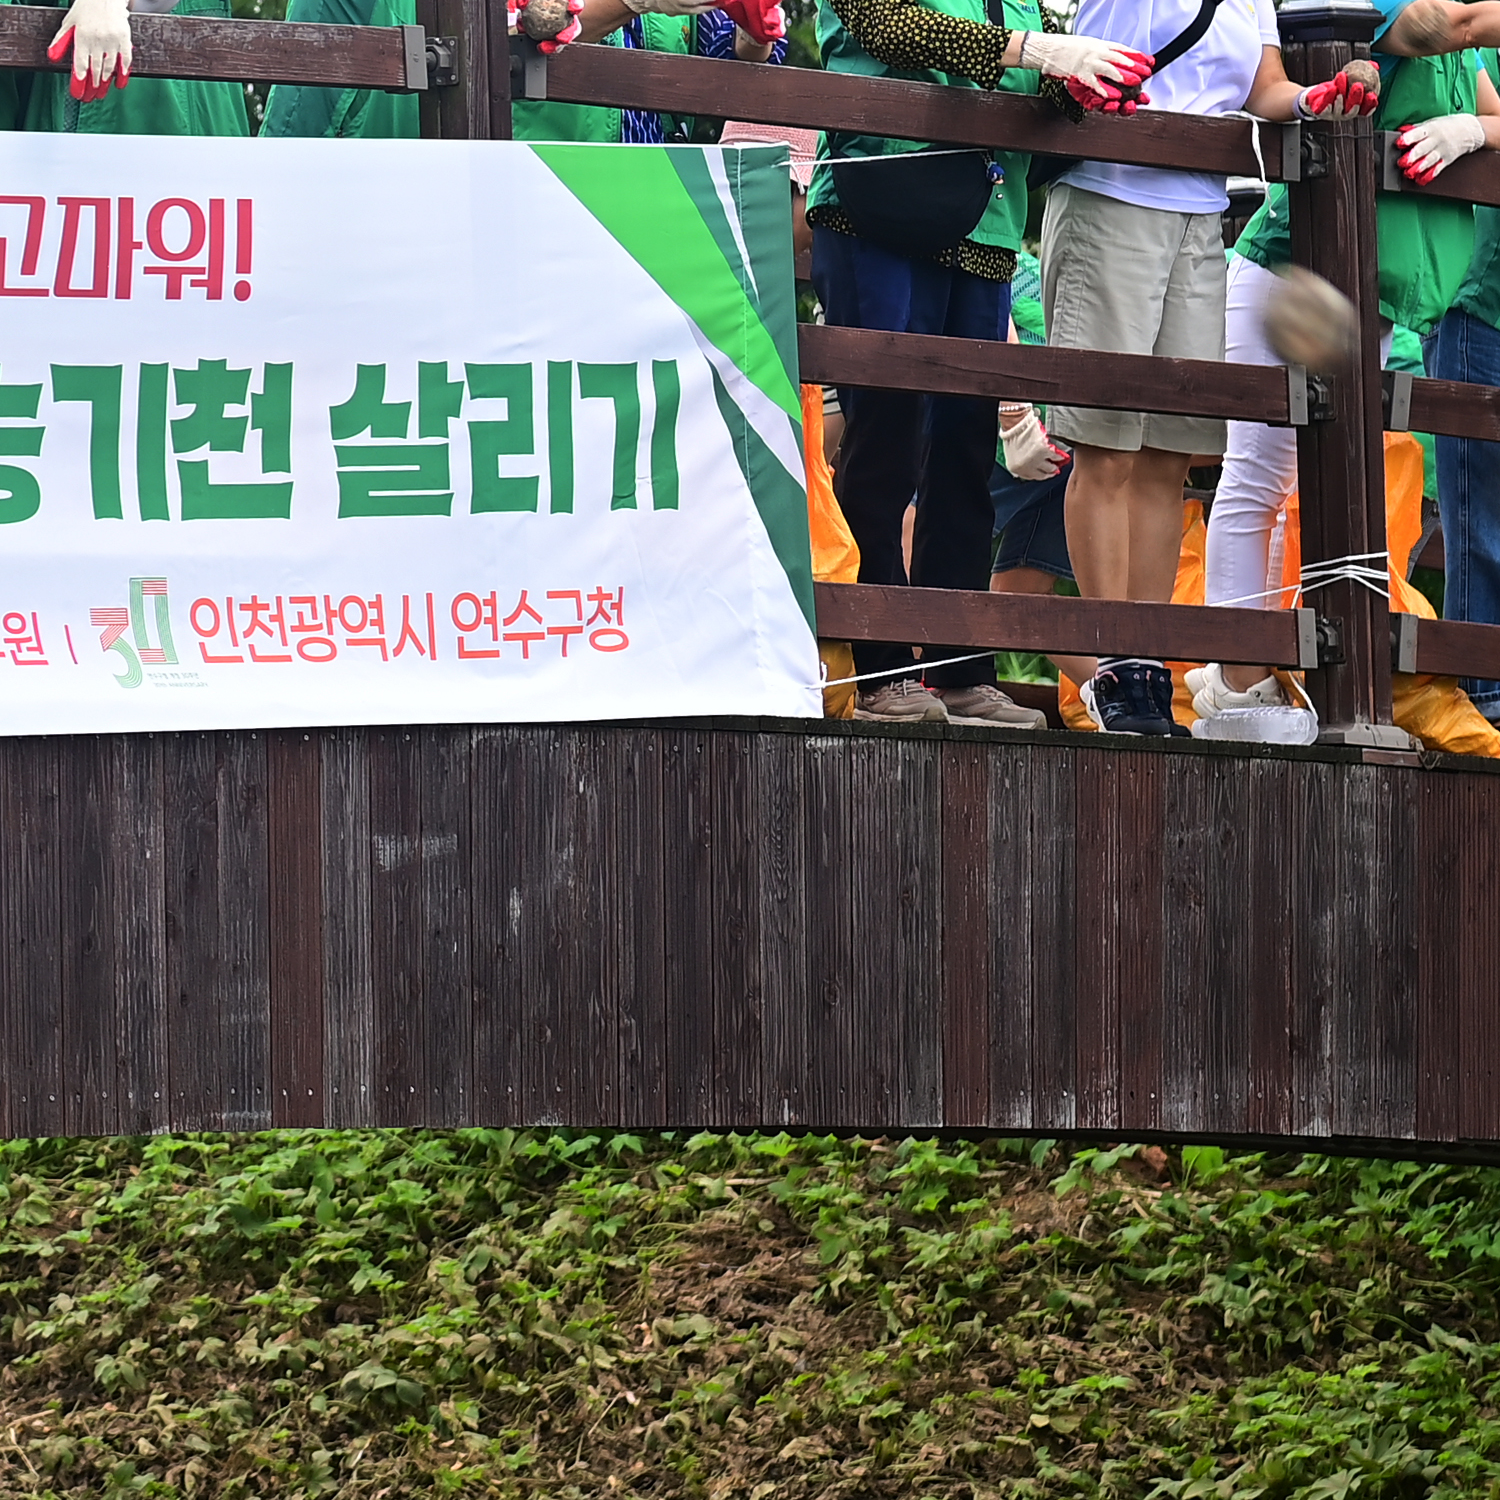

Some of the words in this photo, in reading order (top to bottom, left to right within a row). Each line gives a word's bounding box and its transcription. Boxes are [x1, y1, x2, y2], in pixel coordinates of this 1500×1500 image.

[329, 359, 680, 519] 살리기
[190, 592, 438, 664] 인천광역시
[450, 586, 630, 660] 연수구청
